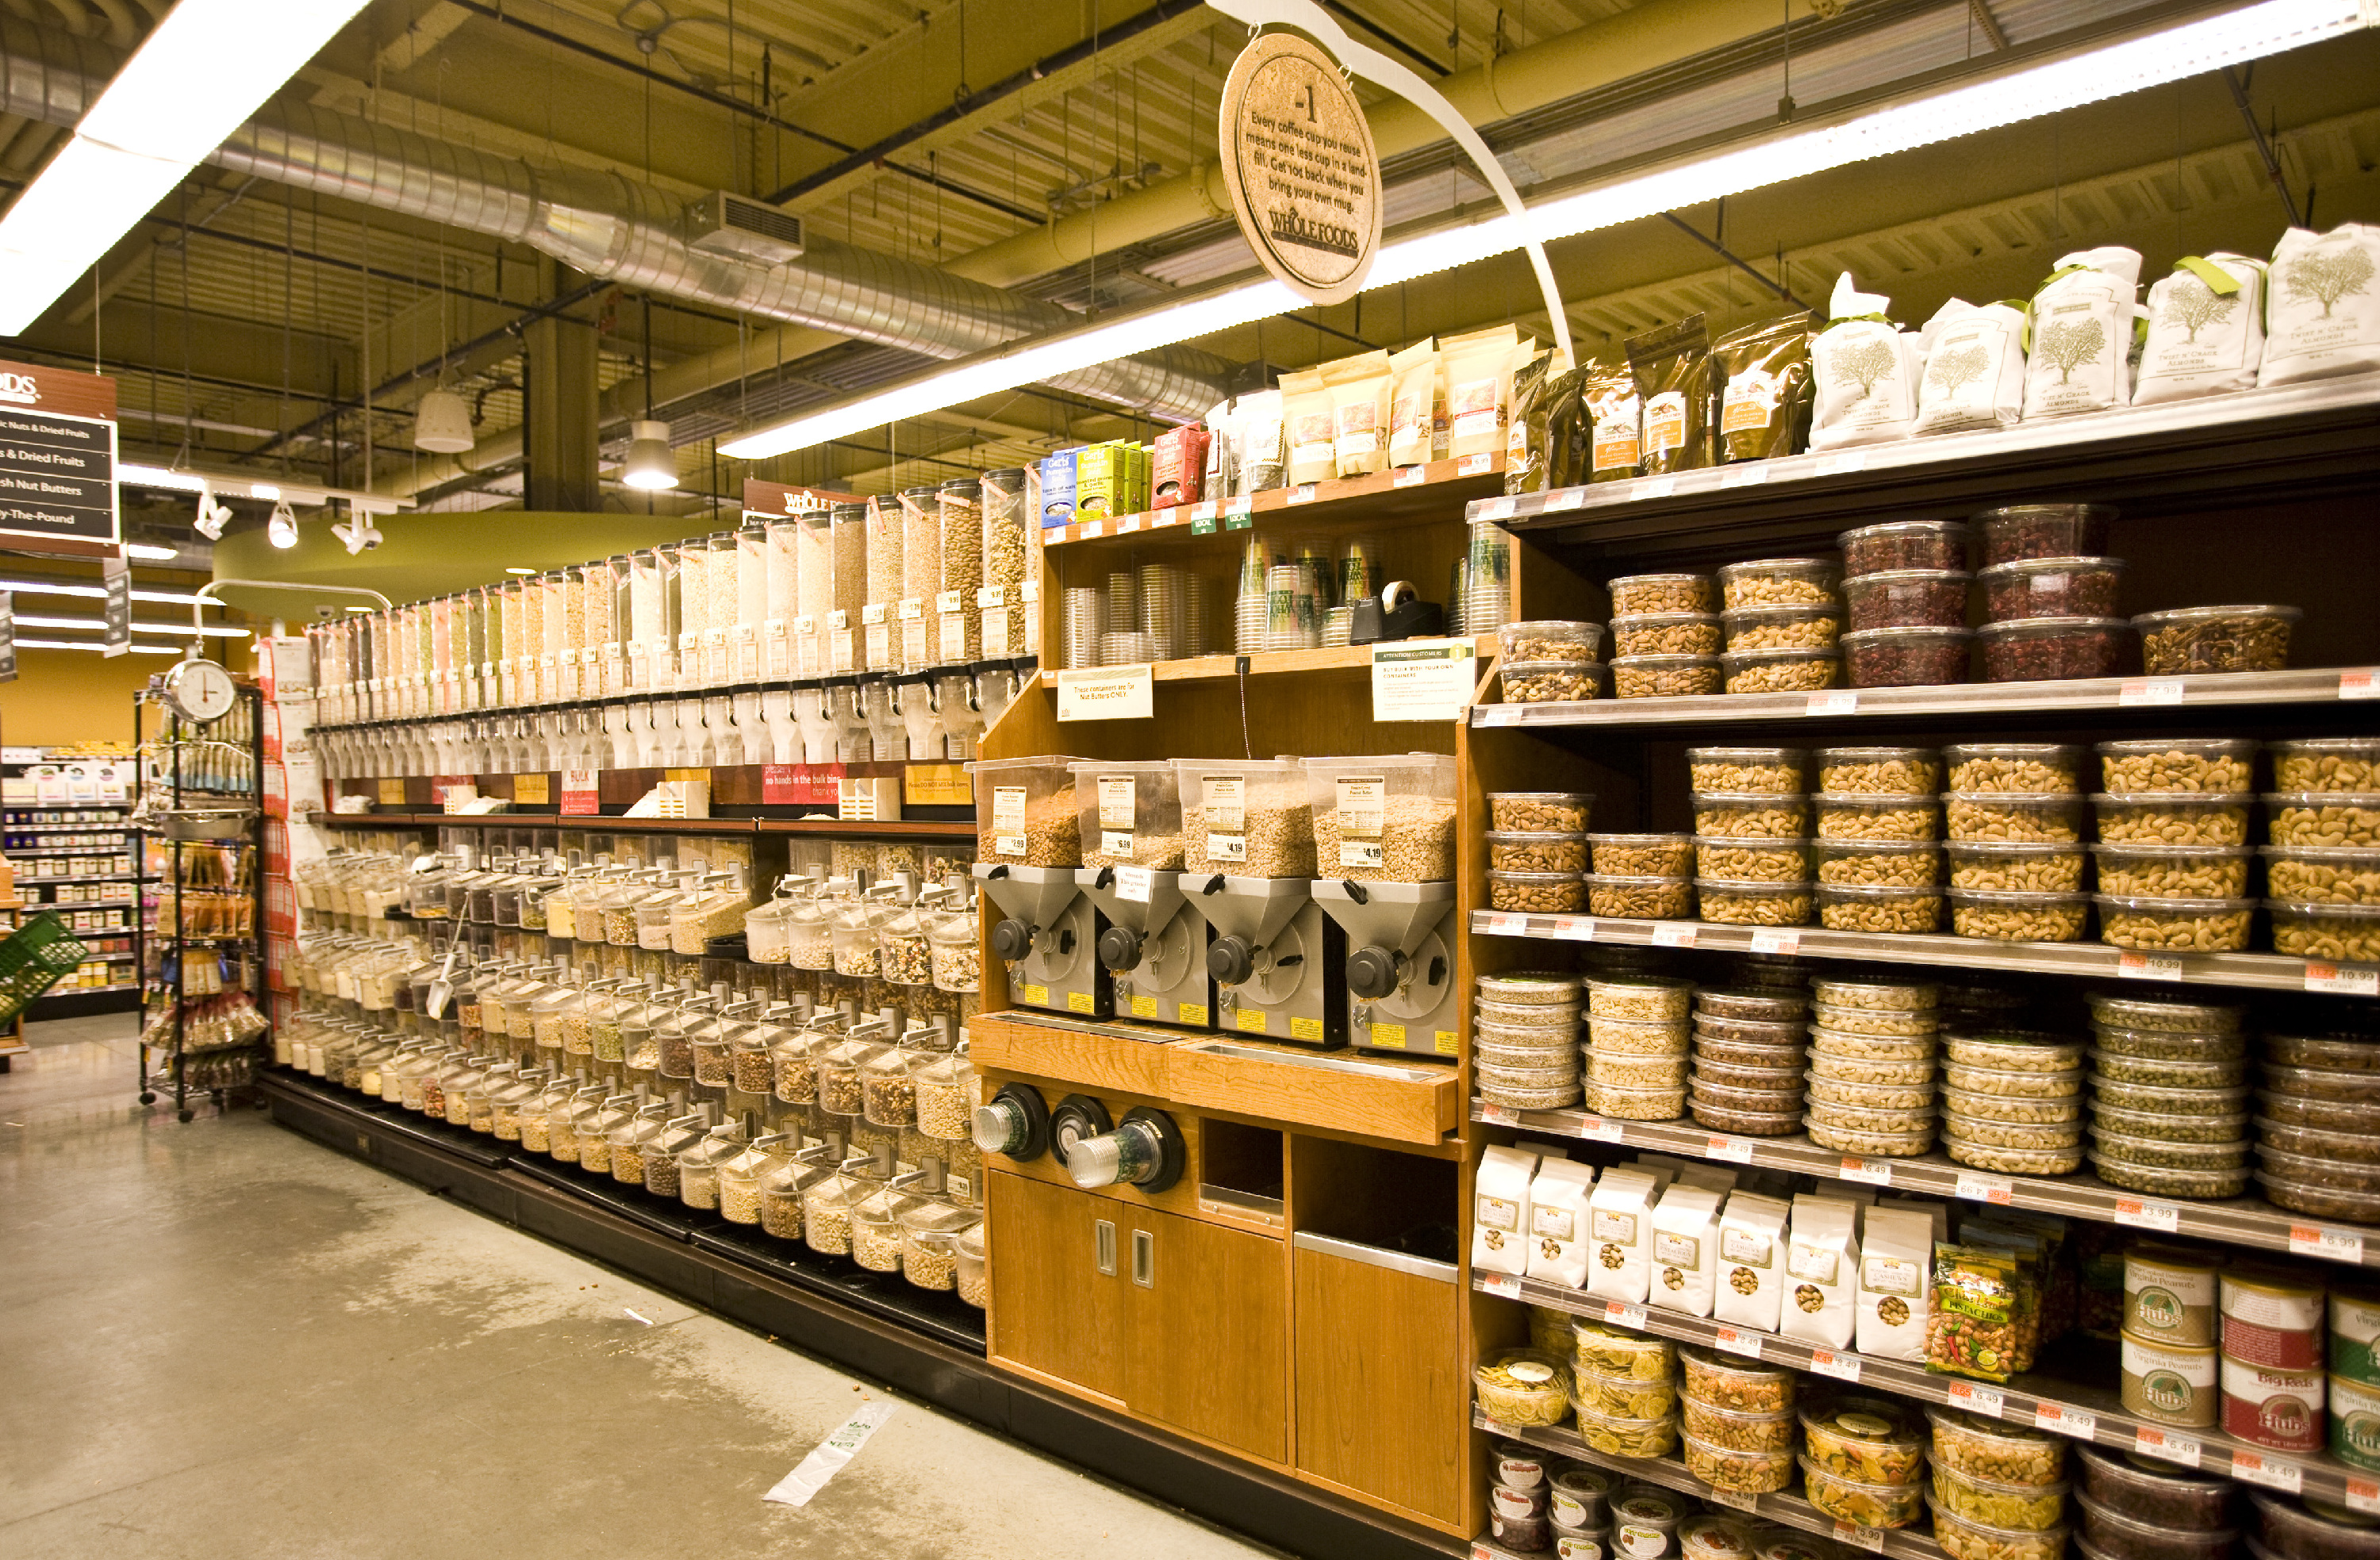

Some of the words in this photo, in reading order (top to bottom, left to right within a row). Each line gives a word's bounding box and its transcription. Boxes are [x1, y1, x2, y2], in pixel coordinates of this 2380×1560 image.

[1295, 86, 1318, 124] -1
[1251, 111, 1276, 133] Every
[1278, 121, 1304, 139] coffee
[1305, 130, 1321, 144] cup
[1322, 136, 1338, 150] you
[1339, 143, 1361, 157] reuse
[1246, 132, 1276, 150] means
[1278, 141, 1295, 156] one
[1296, 144, 1313, 161] less
[1315, 152, 1330, 169] cup
[1332, 157, 1340, 170] in
[1342, 162, 1347, 171] a
[1349, 160, 1367, 178] land-
[1253, 151, 1268, 168] fill.
[1270, 156, 1287, 174] Get
[1305, 166, 1325, 184] back
[1326, 172, 1348, 191] when
[1349, 180, 1364, 196] you
[1269, 175, 1292, 198] bring
[1294, 186, 1313, 201] your
[1315, 190, 1332, 206] own
[1334, 195, 1354, 215] mug.
[1269, 206, 1318, 240] WHOLE
[1317, 222, 1359, 250] FOODS
[0, 373, 37, 395] DS
[9, 421, 30, 431] Nuts
[31, 424, 39, 432] &
[40, 425, 65, 436] Dried
[66, 428, 90, 439] Fruits
[7, 449, 17, 459] &
[18, 450, 52, 464] Dried
[52, 455, 86, 467] Fruits
[16, 478, 39, 491] Nut
[40, 482, 83, 496] Butters
[783, 490, 829, 511] WHOLE
[1195, 519, 1212, 528] LOCAL
[1230, 514, 1247, 523] LOCAL
[774, 774, 793, 786] hands
[793, 774, 799, 785] in
[800, 774, 812, 785] the
[812, 774, 826, 785] bulk
[831, 788, 839, 798] yo
[1226, 842, 1243, 852] $4.19
[1363, 847, 1381, 859] $4.19
[1864, 1162, 1886, 1174] $6.49
[2144, 1205, 2172, 1219] $3.99
[1730, 1243, 1760, 1254] CASHEWS
[1873, 1272, 1908, 1282] CASHEWS
[2129, 1268, 2157, 1283] Virginia
[2159, 1277, 2195, 1289] Peanuts
[1948, 1301, 2005, 1321] PISTACHIOS
[2134, 1302, 2183, 1325] Hubs
[2132, 1350, 2167, 1366] Virginia
[2168, 1360, 2202, 1370] Peanuts
[2258, 1372, 2282, 1387] Big
[2284, 1376, 2313, 1389] Reds
[1972, 1387, 1998, 1404] $6.49
[2142, 1385, 2192, 1408] Hubs
[2063, 1411, 2090, 1427] $6.49
[2259, 1411, 2311, 1431] Hubs
[2166, 1438, 2195, 1453] $6.49
